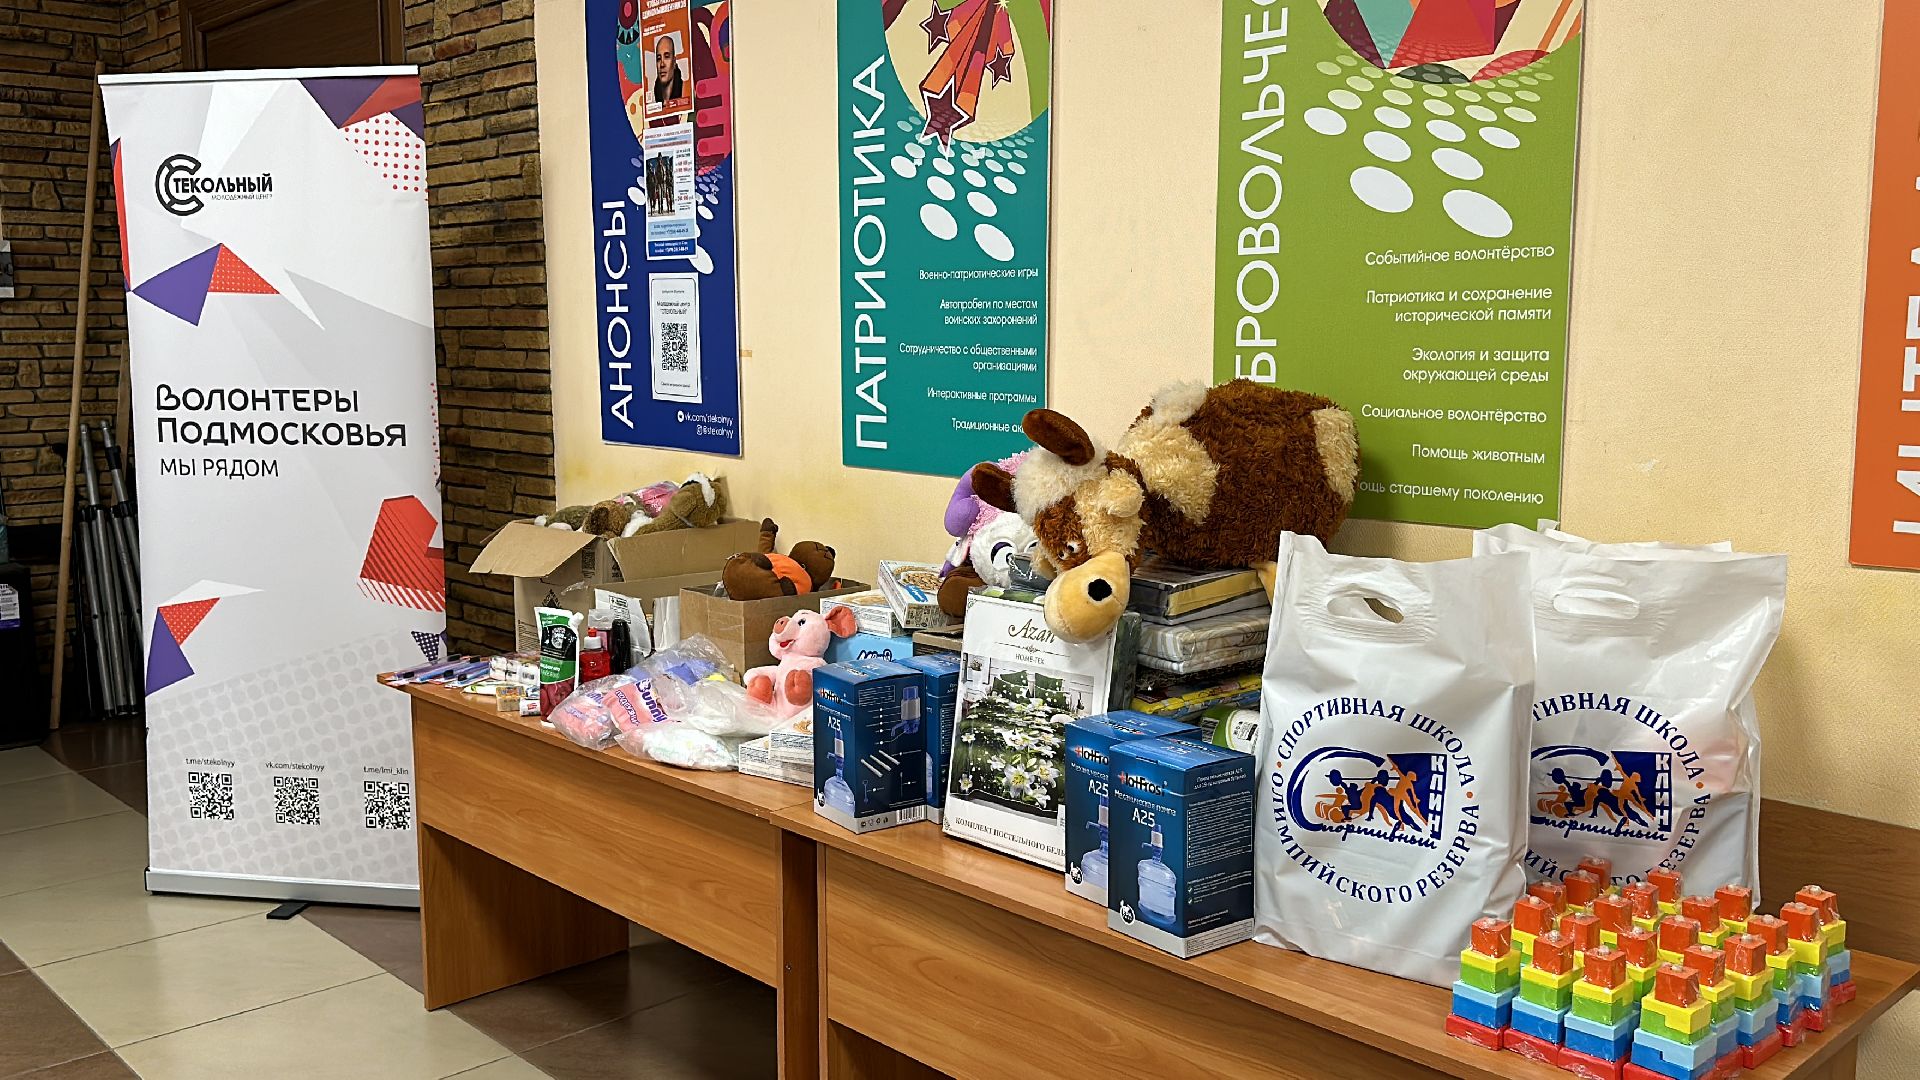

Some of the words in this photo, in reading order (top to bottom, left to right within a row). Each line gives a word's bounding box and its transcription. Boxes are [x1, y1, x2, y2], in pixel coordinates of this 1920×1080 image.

[256, 192, 273, 201] ЦЕНТР
[1235, 0, 1288, 383] БРОВОЛЬЧЕ
[852, 54, 888, 450] ПАТРИОТИКА
[1365, 250, 1450, 265] Событийное
[1454, 246, 1555, 261] волонтёрство
[919, 269, 1016, 282] Военно-патриотические
[1017, 268, 1039, 279] игры
[939, 298, 992, 312] Автопробеги
[992, 301, 1004, 309] по
[1004, 300, 1038, 309] местам
[1366, 290, 1444, 306] Патриотика
[1449, 291, 1458, 301] и
[1461, 287, 1552, 303] сохранение
[602, 200, 634, 429] АНОНСЫ
[944, 315, 981, 325] воинских
[982, 314, 1038, 327] захоронений
[1395, 308, 1494, 325] исторической
[1498, 307, 1551, 321] памяти
[899, 342, 961, 356] Сотрудничество
[962, 347, 969, 355] с
[970, 343, 1037, 357] общественными
[1411, 347, 1475, 361] Экология
[1479, 350, 1489, 361] и
[1493, 350, 1550, 363] защита
[973, 361, 1037, 373] организациями
[1403, 368, 1497, 384] окружающей
[1500, 369, 1549, 384] среды
[927, 387, 987, 400] Интерактивные
[989, 393, 1037, 404] программы
[685, 411, 733, 426] vk.com/stekolnyy
[1361, 403, 1444, 419] Социальное
[1448, 408, 1547, 424] волонтёрство
[952, 418, 1010, 432] Традиционные
[1012, 424, 1025, 434] ак
[1412, 444, 1468, 460] Помощь
[1472, 449, 1545, 464] животным
[160, 458, 196, 476] МЫ
[203, 458, 279, 480] РЯДОМ
[1359, 482, 1385, 493] ощь
[1389, 482, 1460, 501] старшему
[1464, 488, 1544, 505] поколению
[1007, 618, 1056, 645] Azan
[1277, 697, 1406, 761] СПОРТИВНАЯ
[1408, 713, 1475, 787] ШКОЛА
[1532, 692, 1631, 722] ТИВНАЯ
[1635, 705, 1705, 780] ШКОЛА
[186, 757, 235, 768] t.me/stekolnyy
[1073, 747, 1109, 766] HotFro
[265, 761, 325, 773] vk.com/stekolnyy
[1088, 780, 1109, 797] A25
[1428, 755, 1446, 836] КЛИН
[1654, 753, 1671, 826] КЛИН
[1132, 807, 1156, 828] A25
[955, 817, 992, 835] КОМПЛЕКТ
[994, 829, 1046, 851] ПОСТЕЛЬНОГО
[1271, 772, 1413, 904] ОЛИМПИЙСКОГО
[1416, 804, 1480, 898] РЕЗЕРВА
[1650, 793, 1712, 873] ЕЗЕРВА
